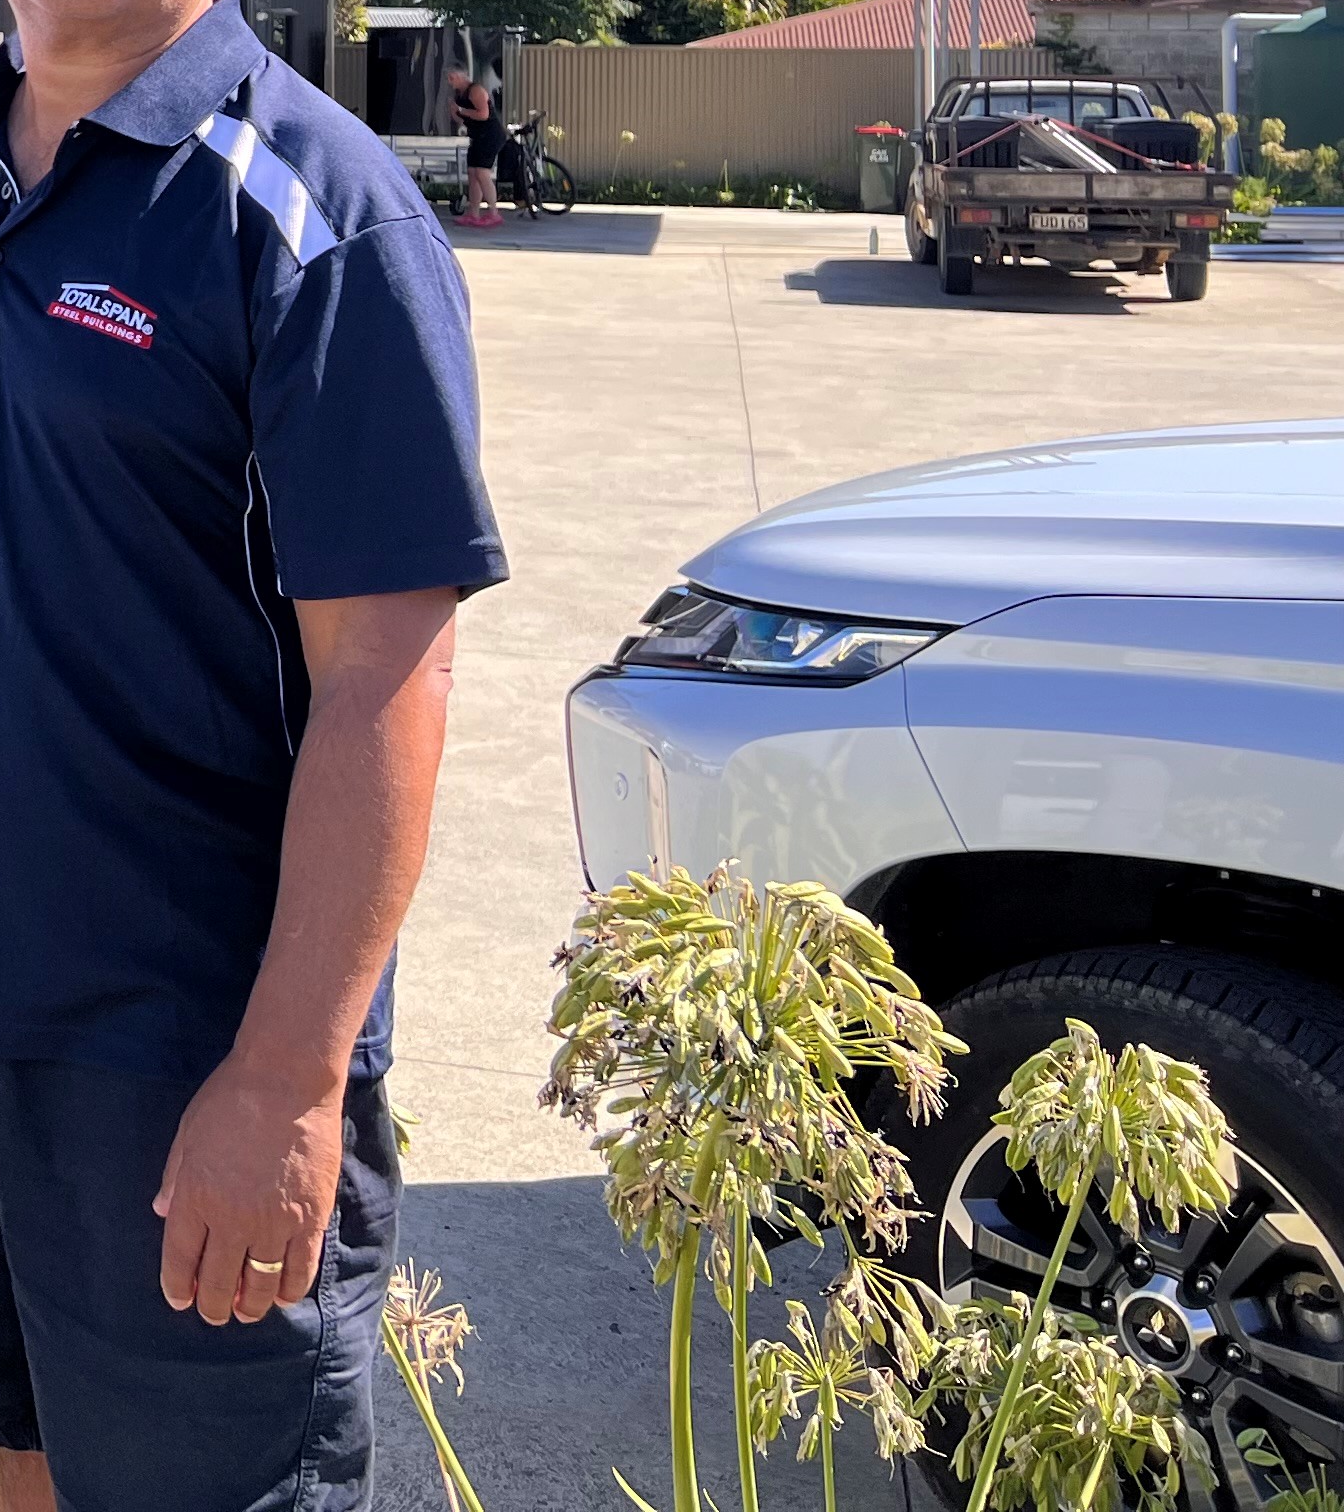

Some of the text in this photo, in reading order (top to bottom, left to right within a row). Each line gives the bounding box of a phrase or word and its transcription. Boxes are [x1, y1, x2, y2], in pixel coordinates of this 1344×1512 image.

[52, 305, 143, 344] STEEL BUILDINGS
[58, 284, 146, 331] TOTALSPAN
